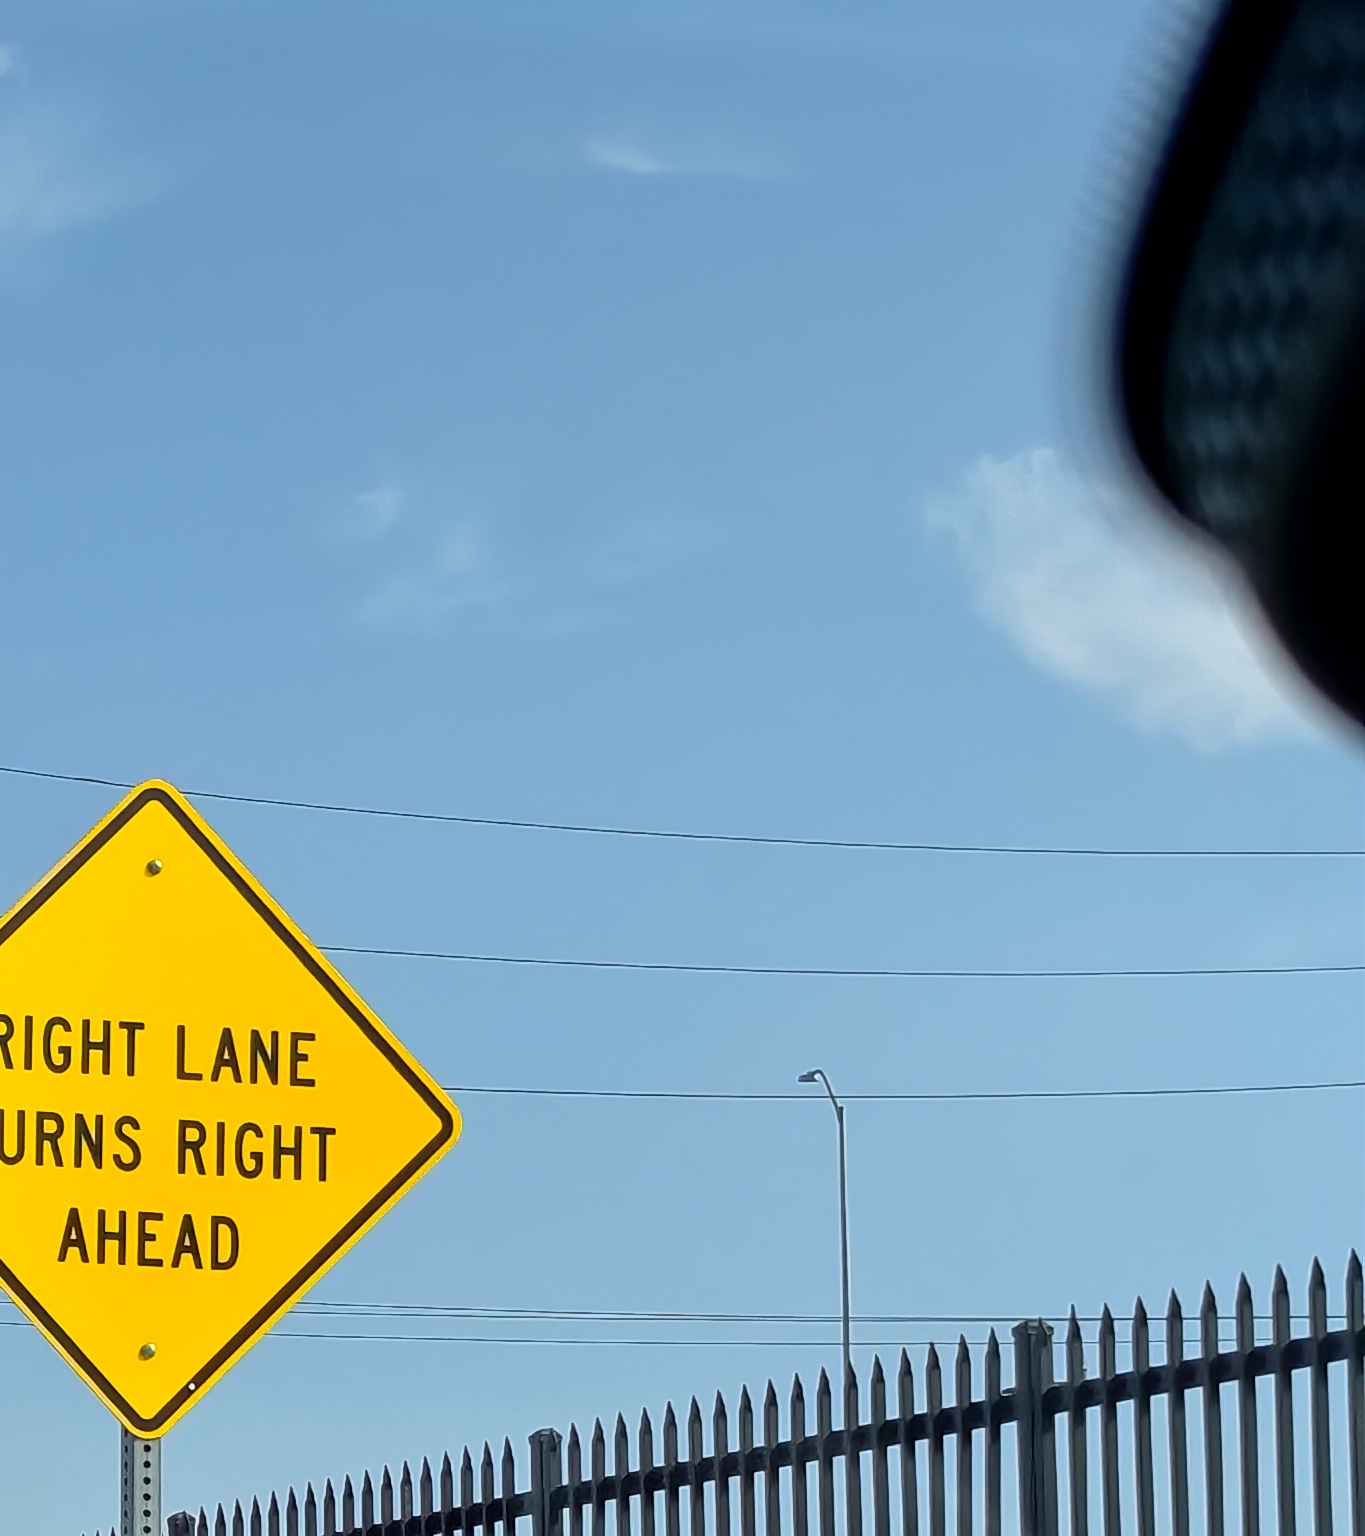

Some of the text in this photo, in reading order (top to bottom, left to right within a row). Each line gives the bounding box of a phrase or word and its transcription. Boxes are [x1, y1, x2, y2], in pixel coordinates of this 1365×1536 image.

[175, 1024, 317, 1088] LANE
[176, 1119, 337, 1183] RIGHT
[56, 1207, 241, 1271] AHEAD
